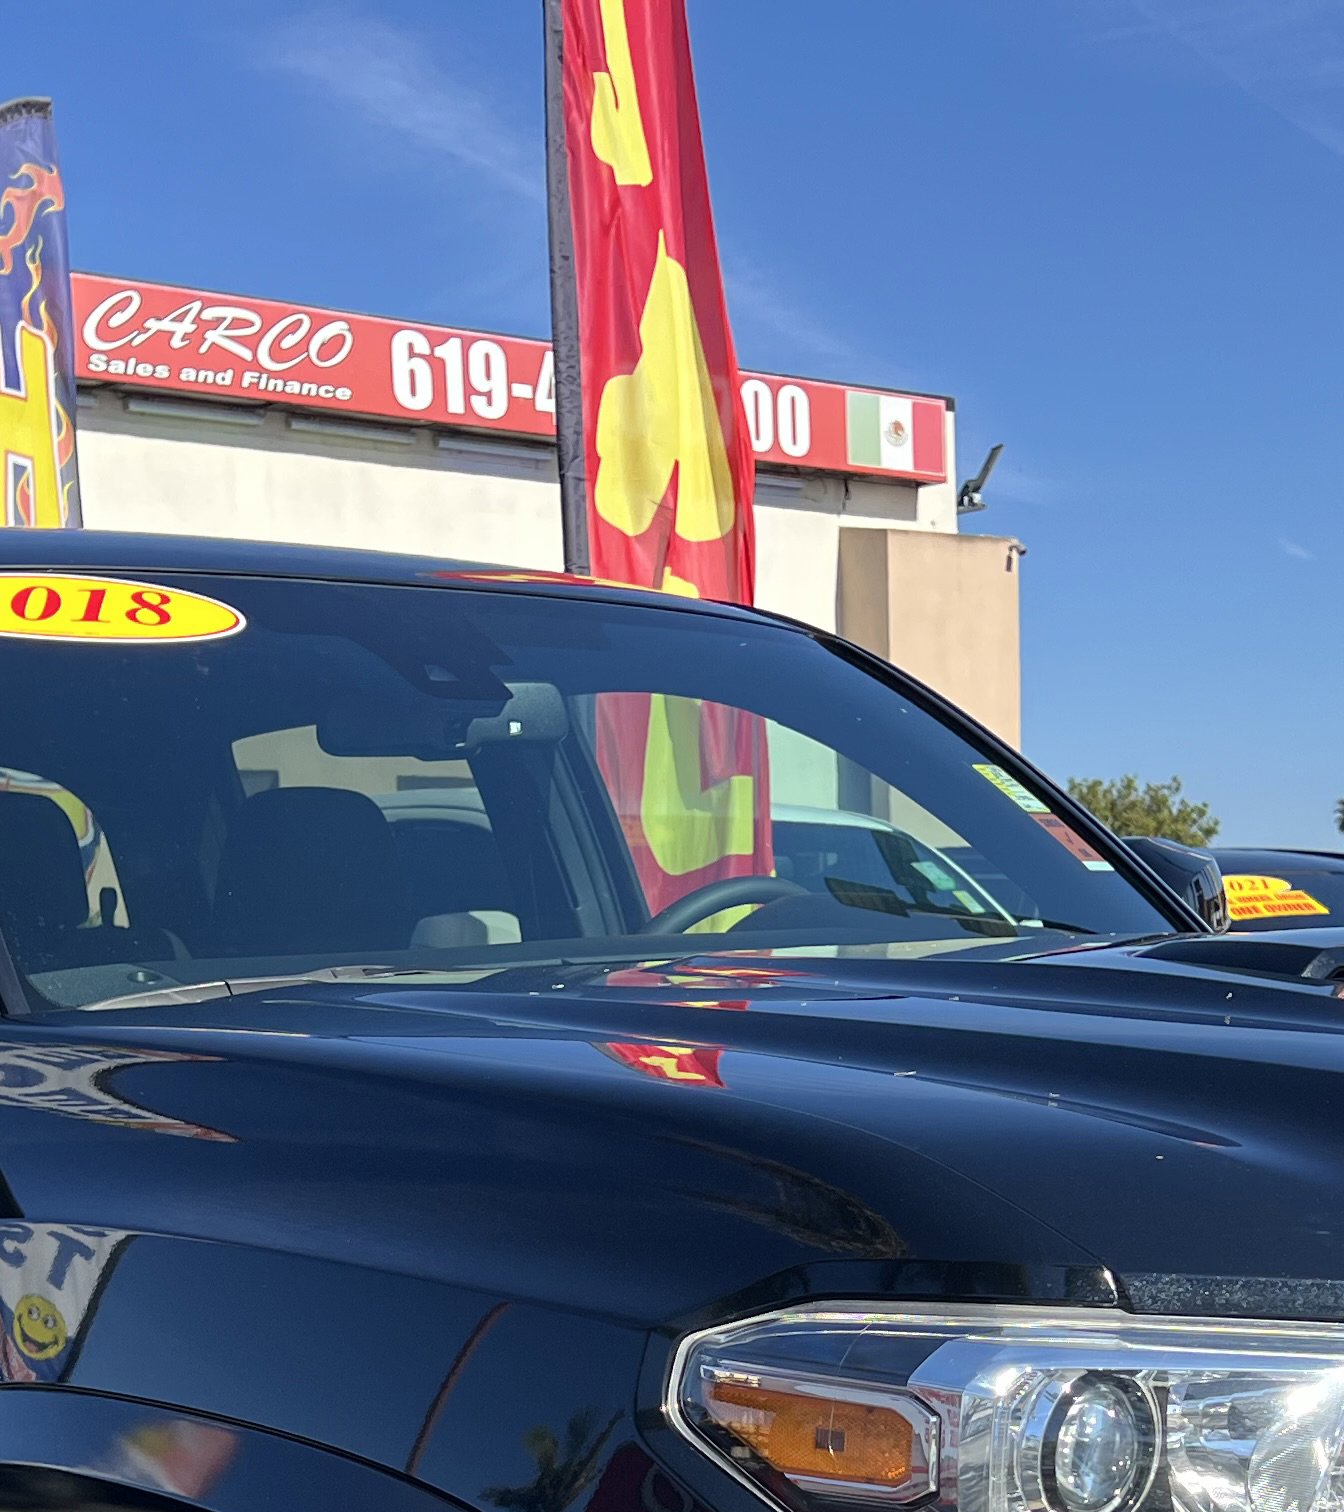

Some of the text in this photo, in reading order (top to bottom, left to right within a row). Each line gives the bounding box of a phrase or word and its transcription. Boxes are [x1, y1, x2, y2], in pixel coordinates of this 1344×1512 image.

[82, 290, 354, 372] CARCO
[87, 352, 353, 401] Sales and Finance
